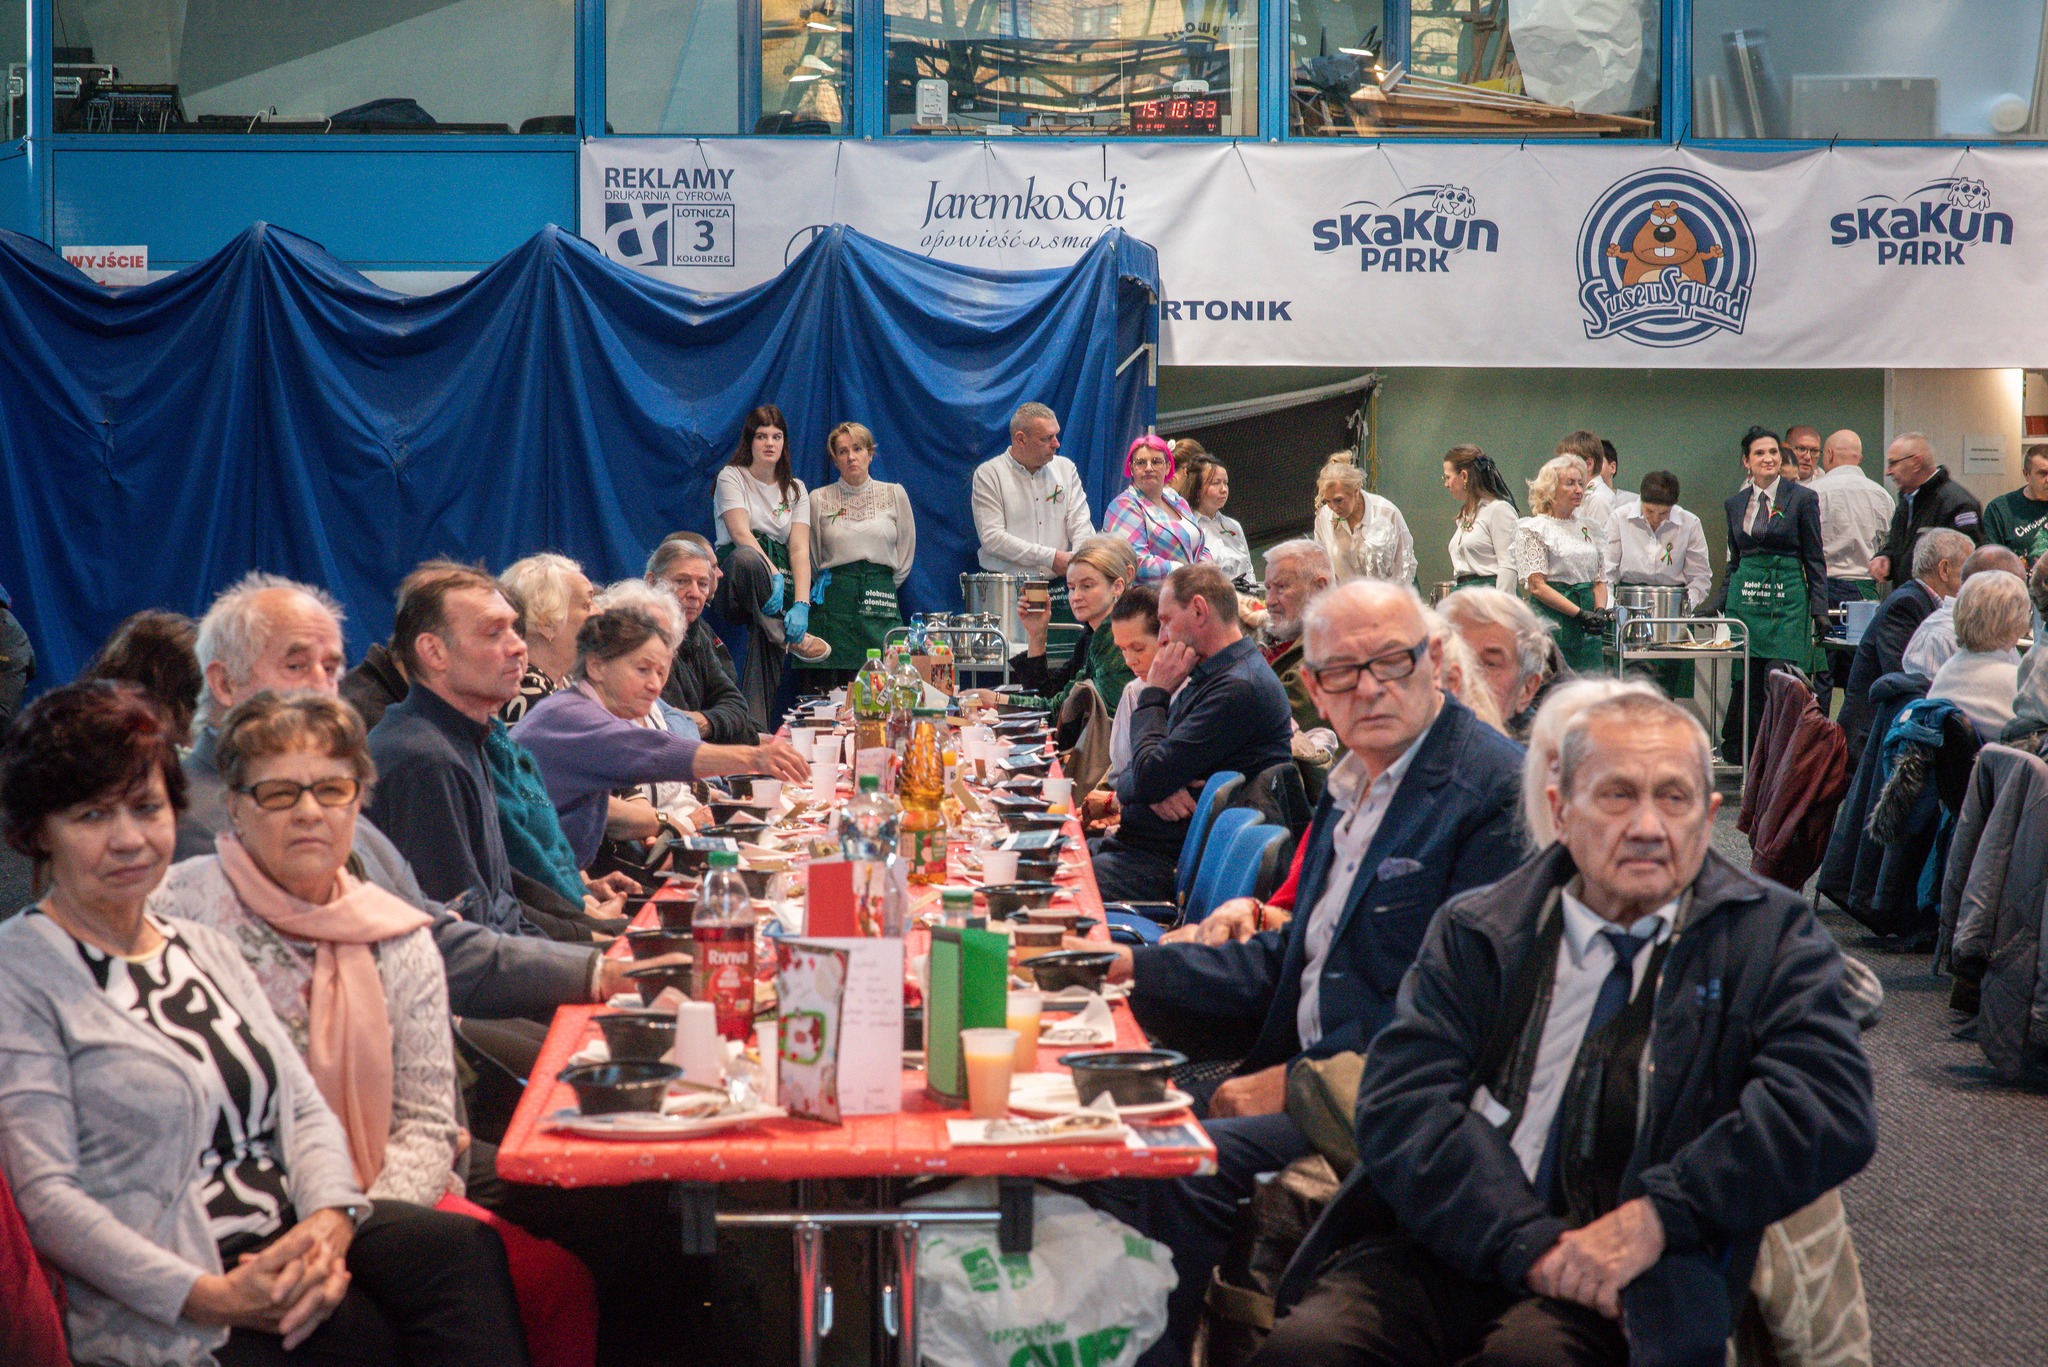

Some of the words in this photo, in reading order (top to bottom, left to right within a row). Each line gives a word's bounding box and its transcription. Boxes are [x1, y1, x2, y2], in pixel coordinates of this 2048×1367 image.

[1142, 101, 1216, 118] 15:10:33
[605, 167, 735, 190] REKLAMY
[604, 190, 671, 201] DRUKARNIA
[676, 191, 732, 202] CYFROWA
[920, 175, 1127, 230] JaremkoSoli
[676, 208, 730, 218] LOTNICZA
[693, 220, 715, 252] 3
[1044, 232, 1099, 249] sma
[66, 251, 145, 269] WYJŚCIE
[676, 255, 731, 263] KOŁOBRZEG
[1361, 247, 1450, 273] PARK
[1878, 240, 1966, 266] PARK
[1160, 300, 1293, 322] RTONIK
[860, 598, 897, 608] olontariusz
